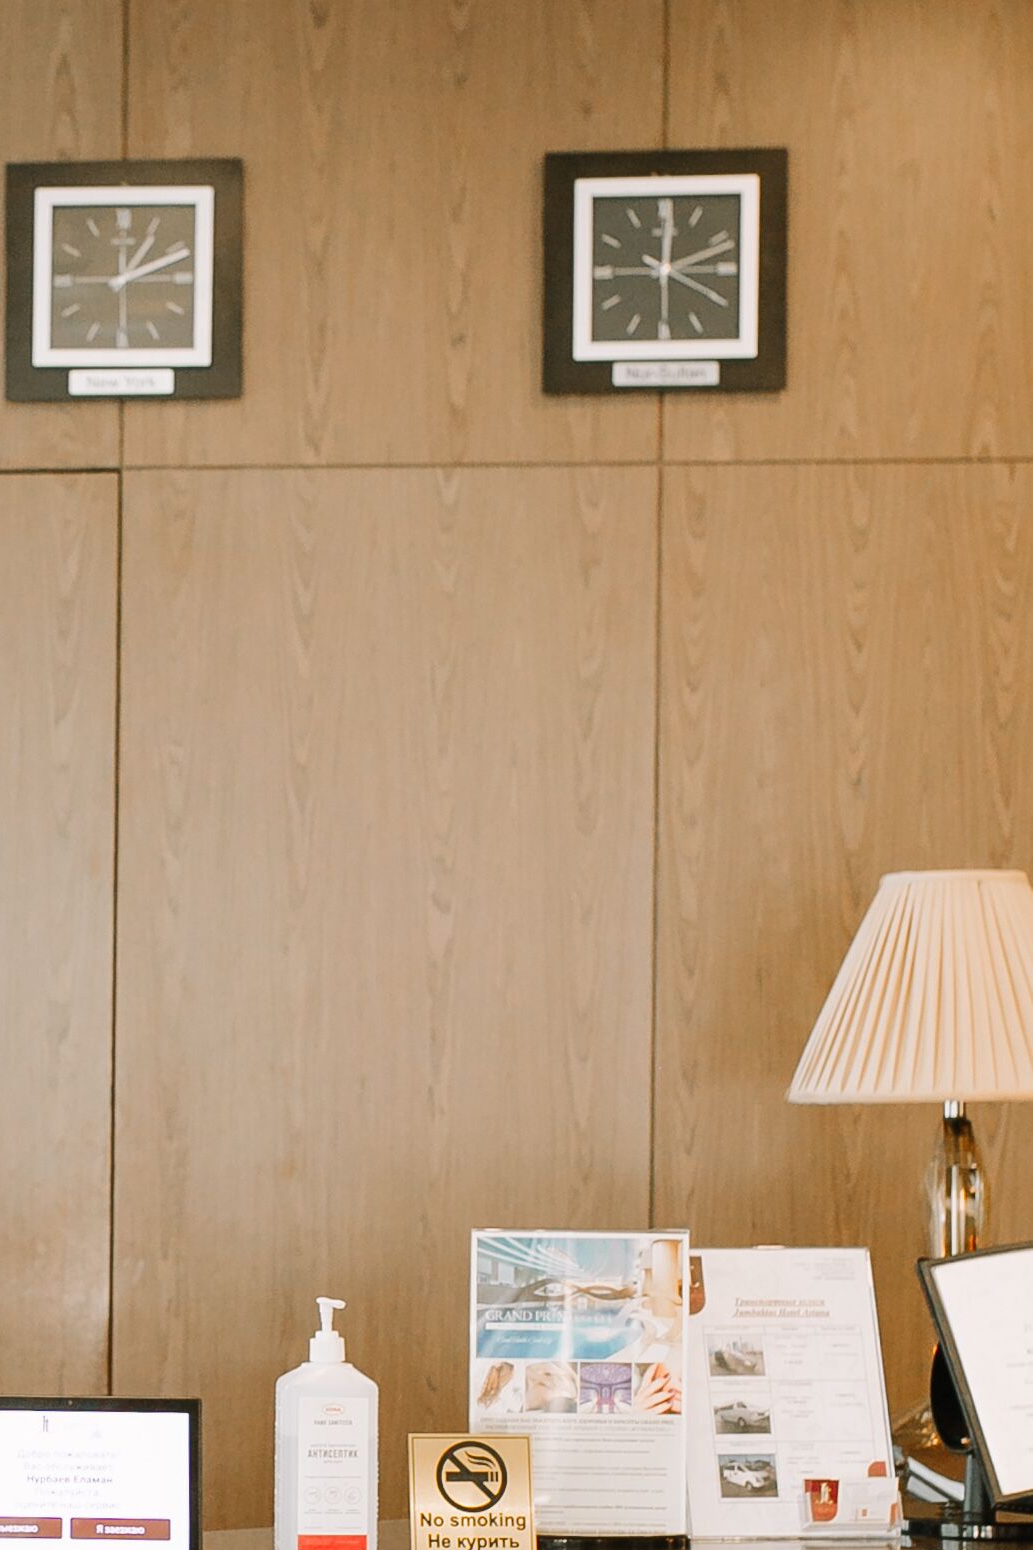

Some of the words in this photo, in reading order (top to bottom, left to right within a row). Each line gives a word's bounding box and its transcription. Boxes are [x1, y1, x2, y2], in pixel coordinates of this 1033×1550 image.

[485, 1309, 533, 1322] GRAND
[307, 1449, 358, 1458] АНТИСЕПТИК
[73, 1474, 112, 1484] Еламан
[420, 1512, 444, 1527] No
[450, 1512, 526, 1531] smoking
[96, 1524, 104, 1534] Я
[428, 1534, 451, 1548] Не
